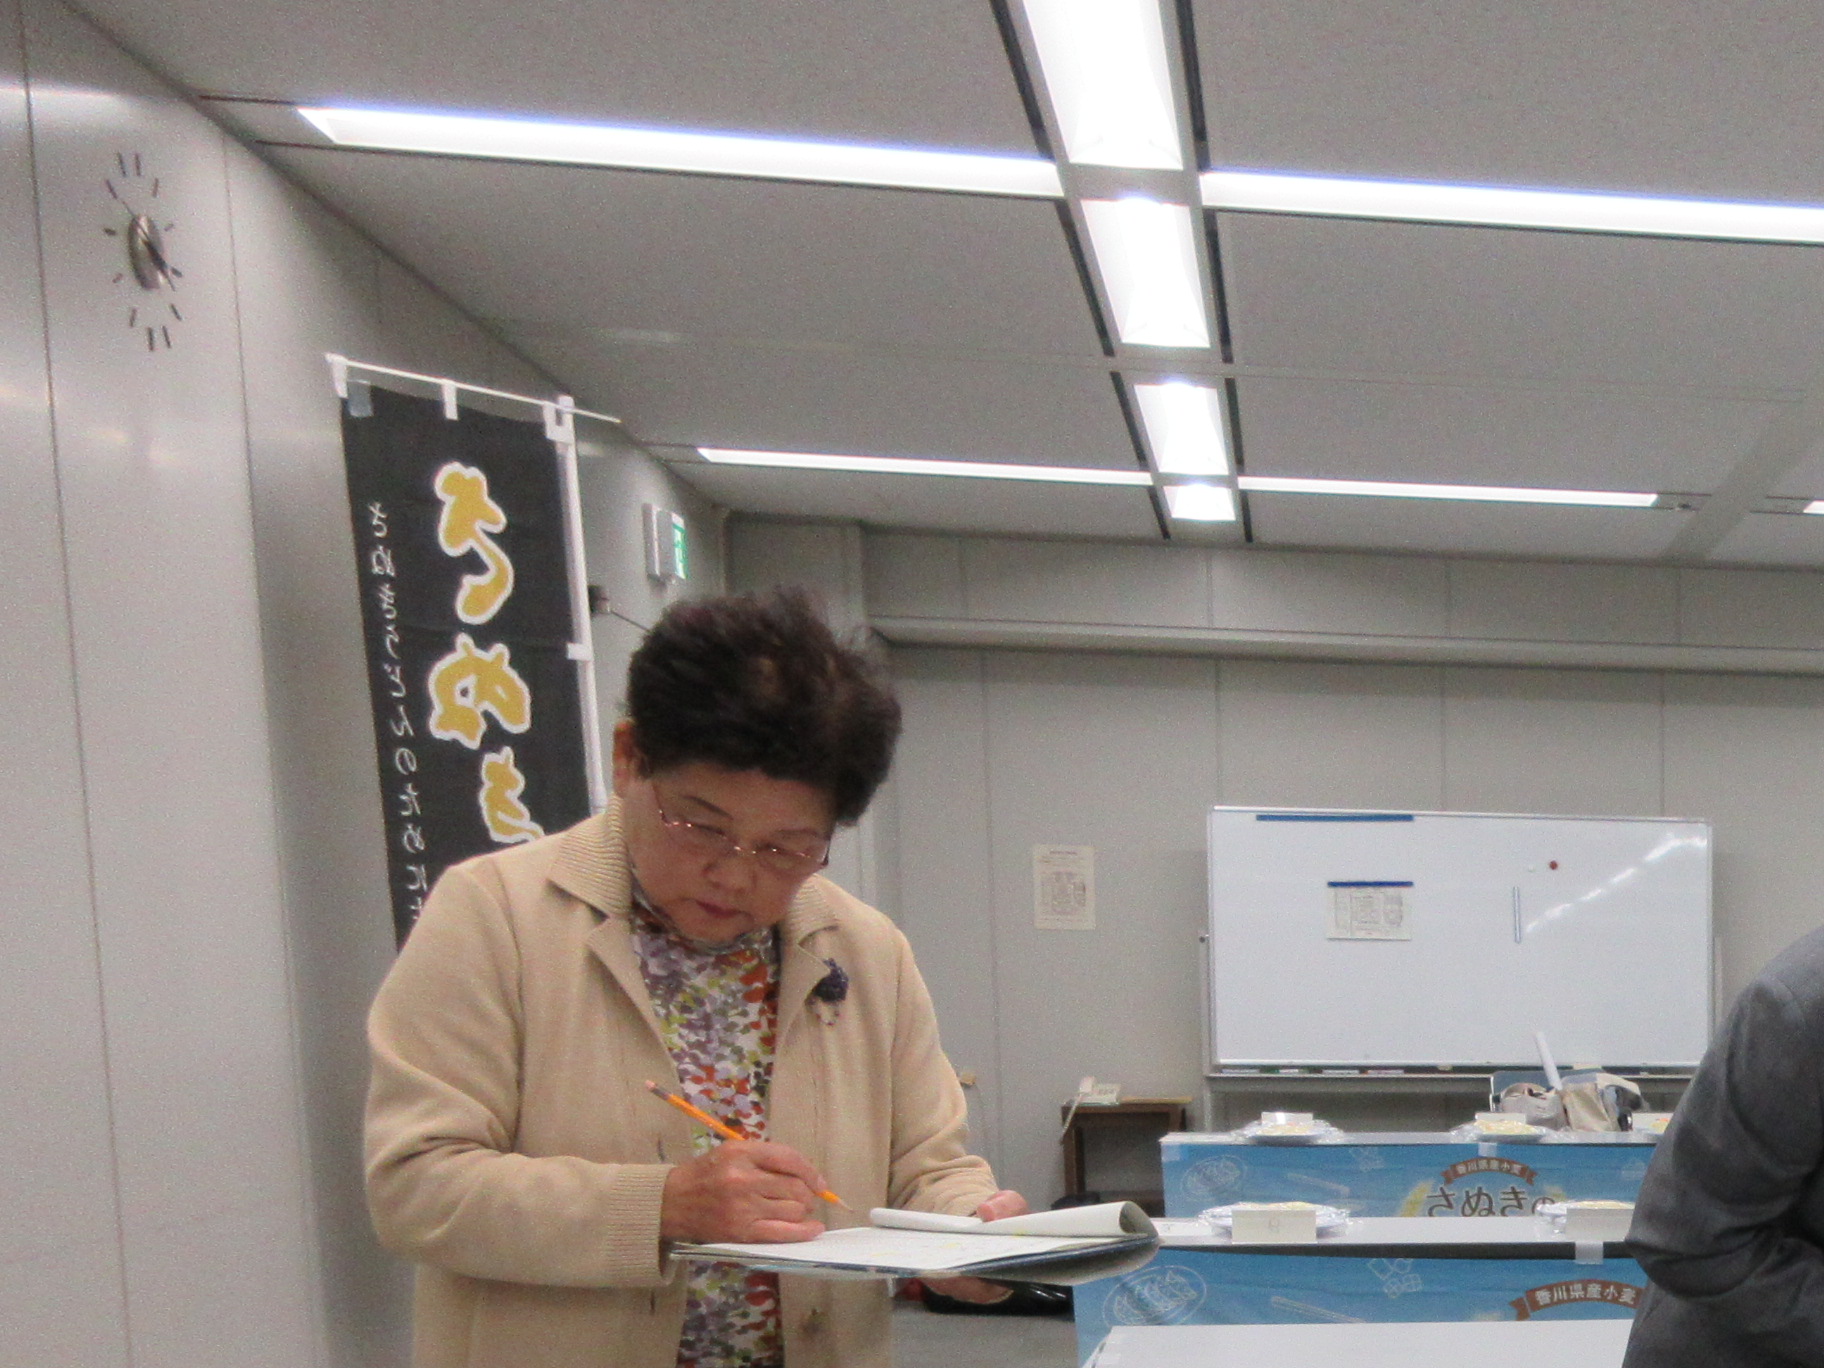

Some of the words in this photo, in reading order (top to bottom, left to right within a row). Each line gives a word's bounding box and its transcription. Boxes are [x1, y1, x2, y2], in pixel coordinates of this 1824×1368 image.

[1534, 1282, 1637, 1306] 香川県産小麦
